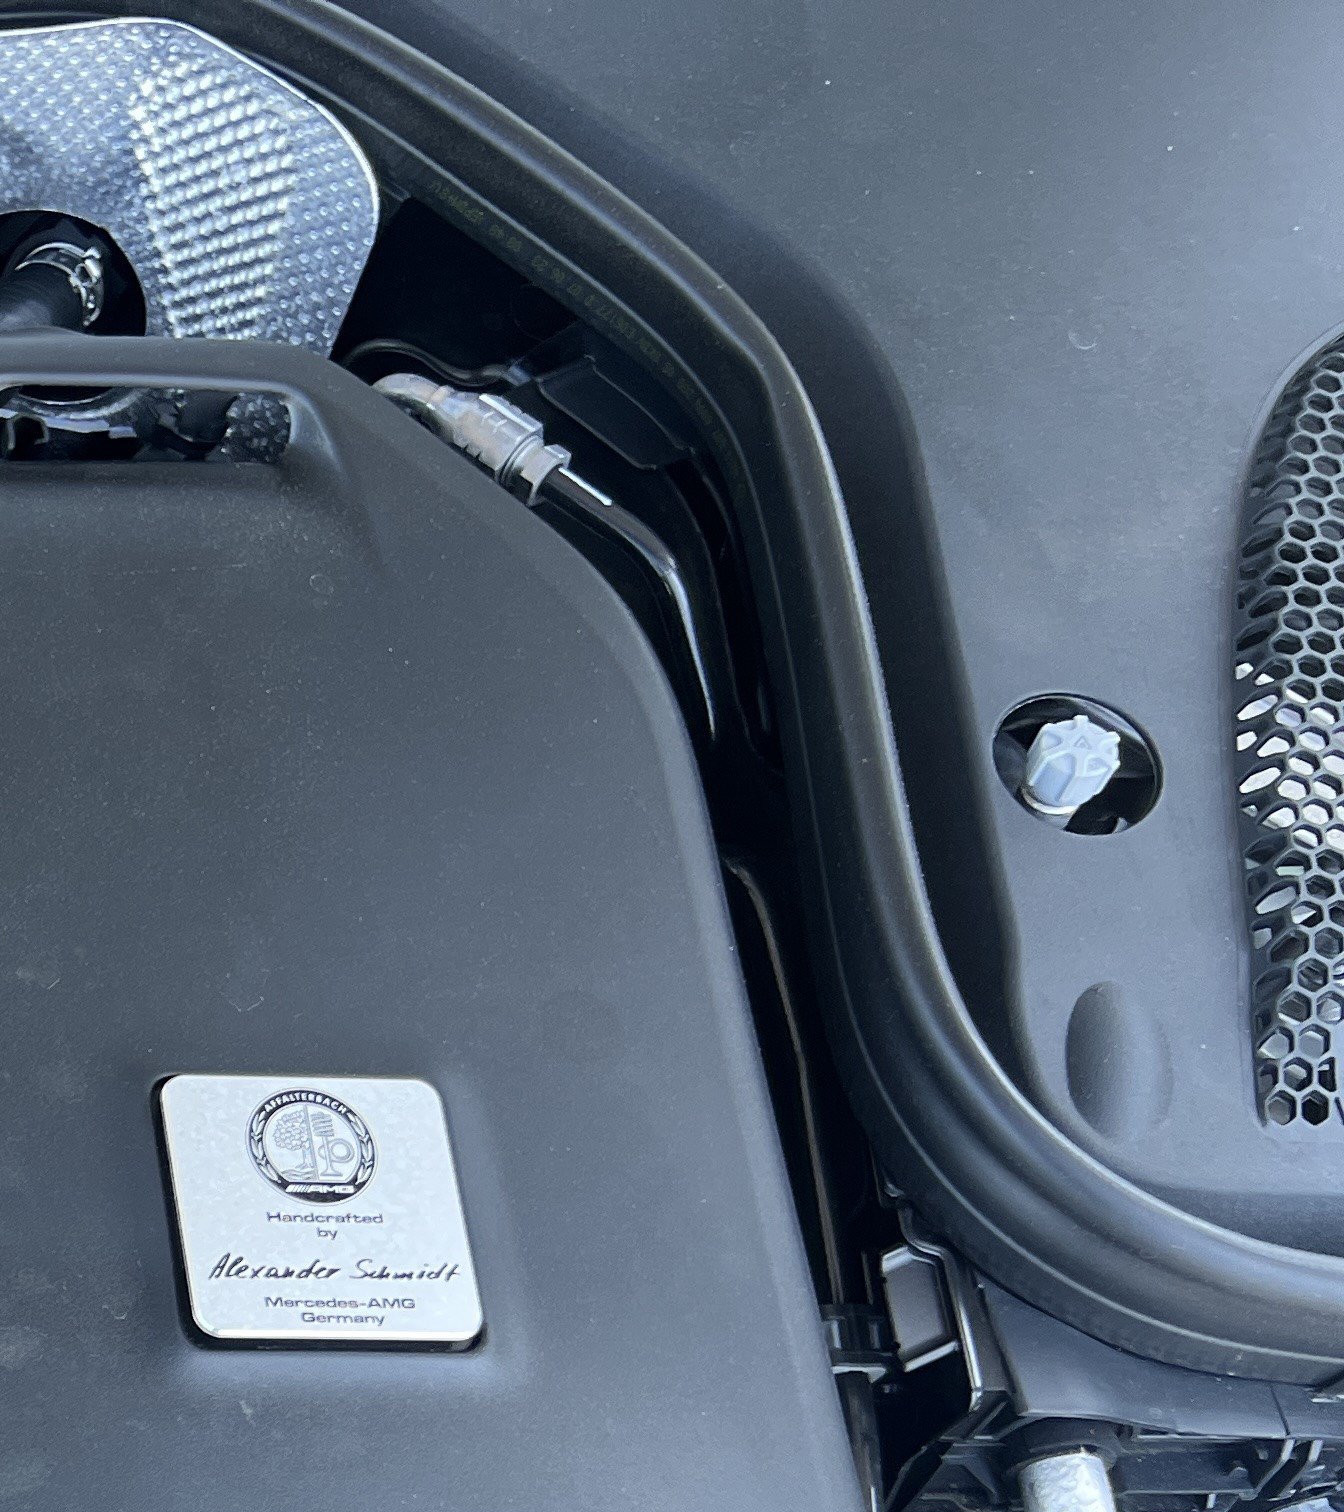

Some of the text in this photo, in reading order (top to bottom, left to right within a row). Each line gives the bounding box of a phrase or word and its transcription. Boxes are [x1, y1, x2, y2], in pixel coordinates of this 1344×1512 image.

[264, 1092, 348, 1115] AFFALTERBACH
[266, 1212, 384, 1224] Handcrafted
[316, 1227, 338, 1240] by
[208, 1252, 460, 1283] Alexander Schmidt
[264, 1296, 416, 1309] Mercedes-AMG
[301, 1312, 386, 1326] Germany
